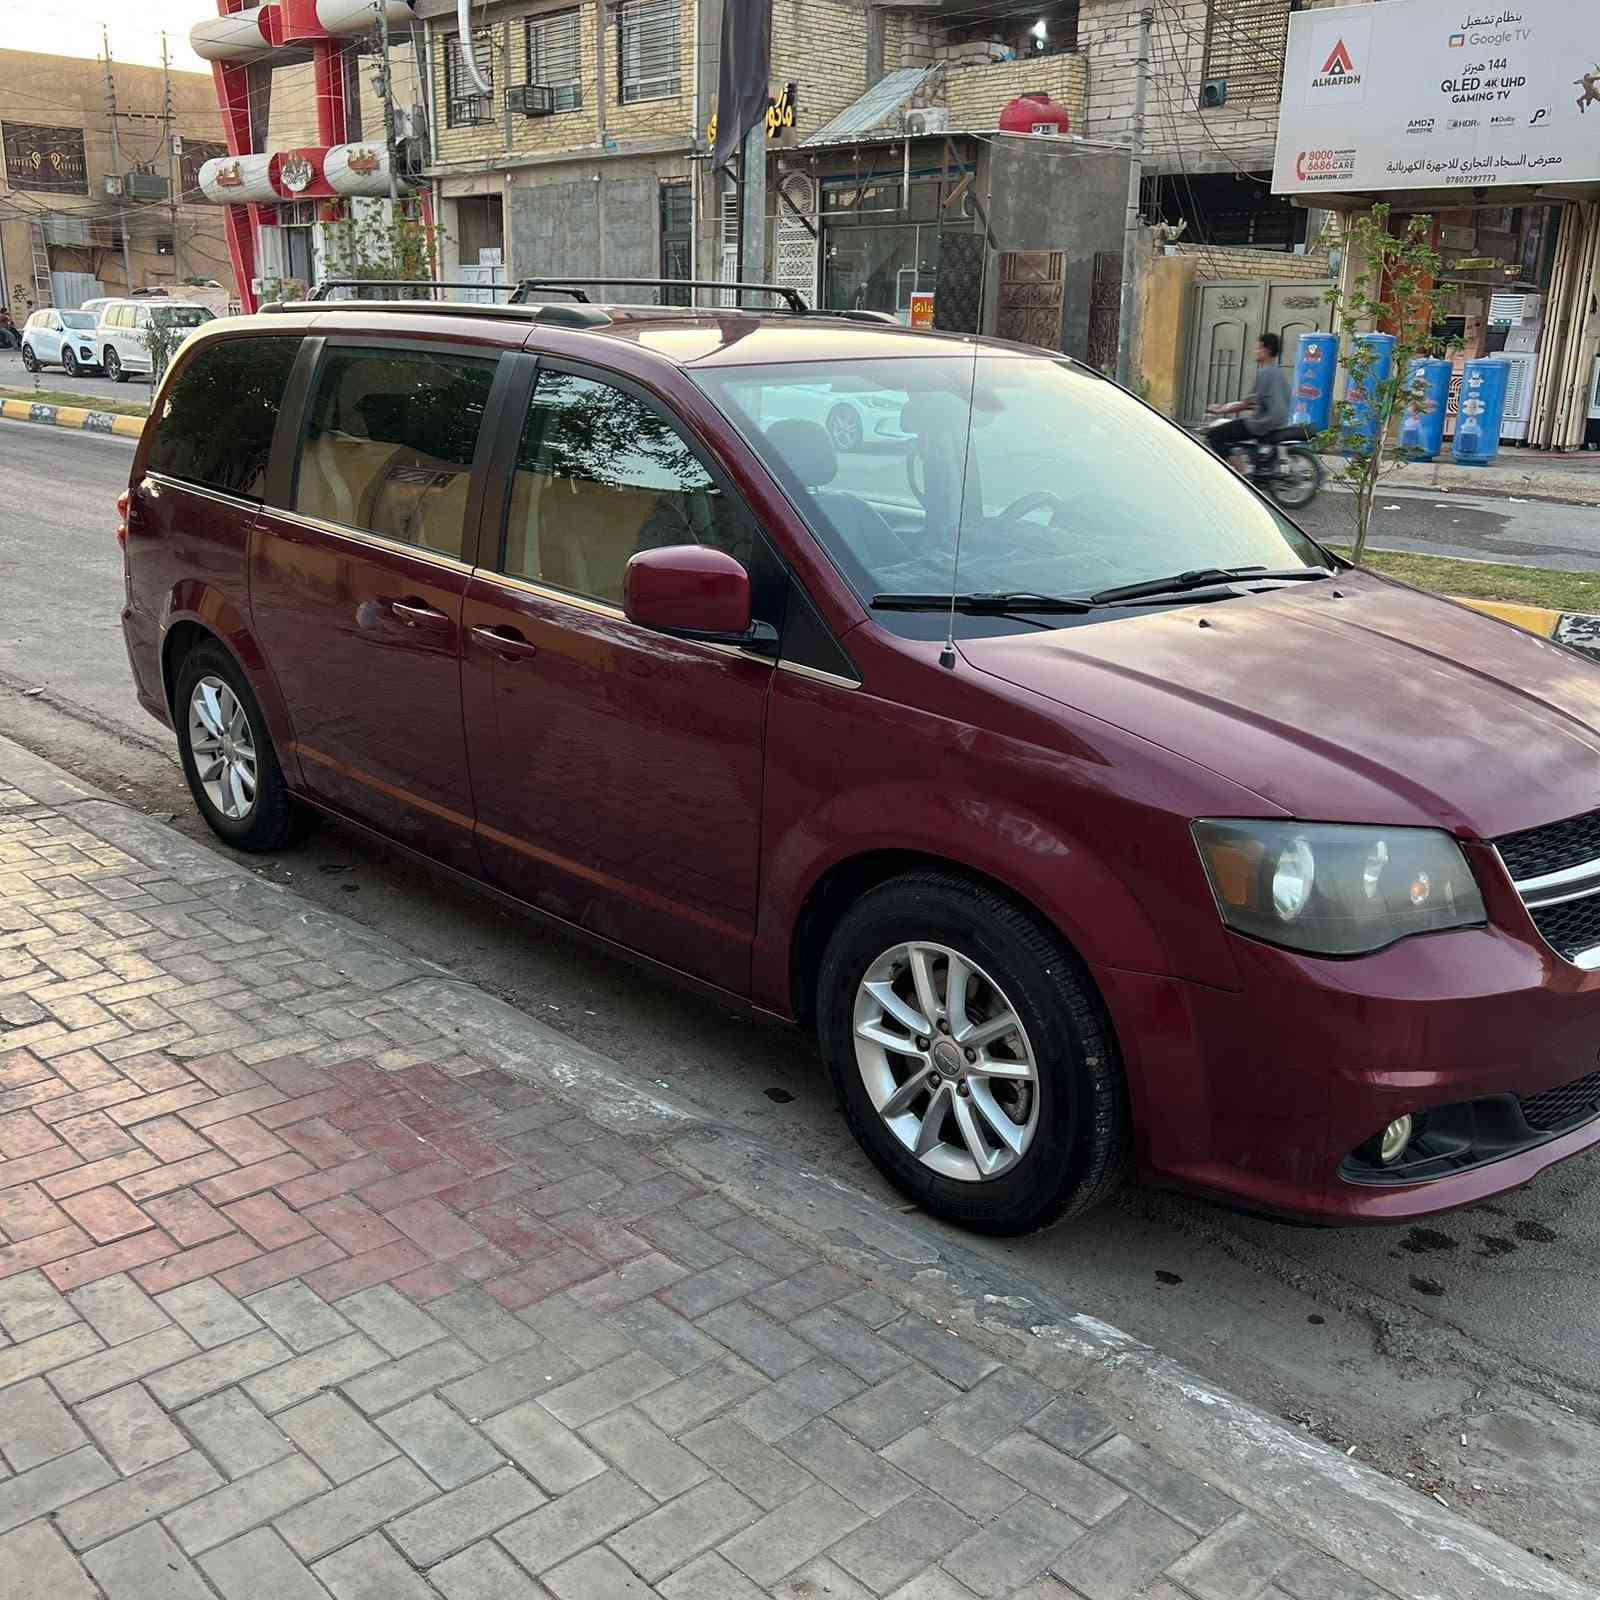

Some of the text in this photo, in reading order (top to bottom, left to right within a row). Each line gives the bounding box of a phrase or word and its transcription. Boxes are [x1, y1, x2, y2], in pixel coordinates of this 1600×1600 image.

[1460, 10, 1522, 30] بنظام تشغيل
[1469, 29, 1530, 46] Google TV
[1488, 58, 1507, 70] 144
[1311, 74, 1361, 88] ALHAFIDH
[1440, 76, 1526, 93] QLED 4K UHD
[1451, 90, 1511, 104] GAMING TV
[1407, 119, 1428, 128] AMD
[1308, 150, 1334, 161] 8000
[1494, 153, 1527, 169] السجاد
[1527, 154, 1563, 169] معرض
[1460, 155, 1494, 174] التجاري
